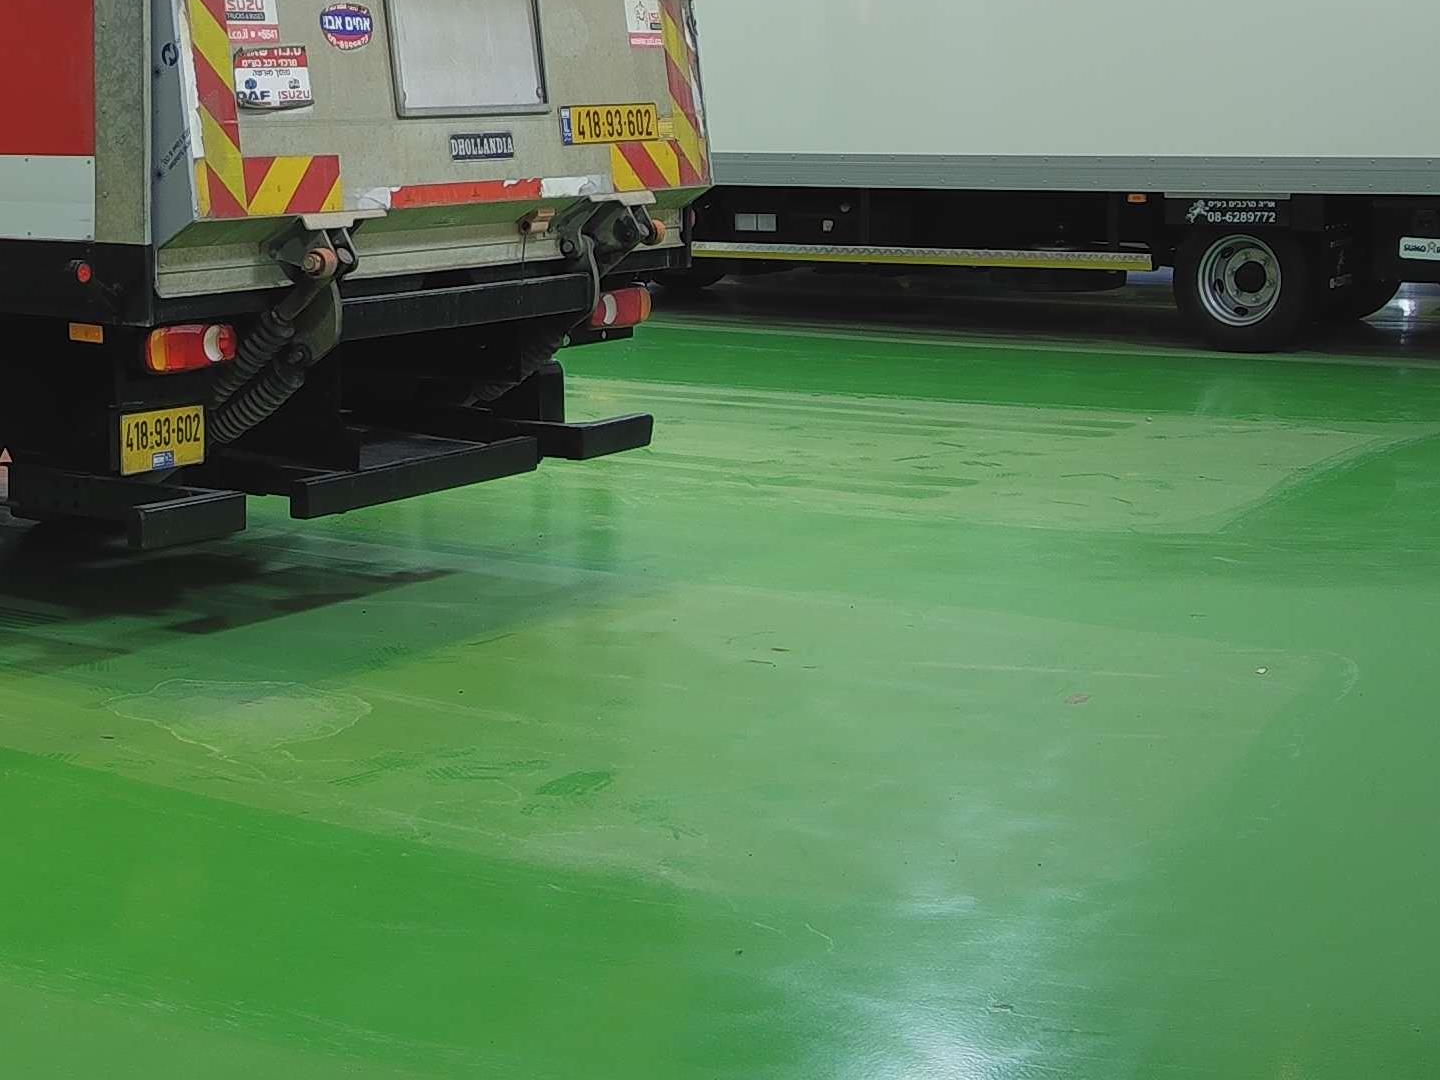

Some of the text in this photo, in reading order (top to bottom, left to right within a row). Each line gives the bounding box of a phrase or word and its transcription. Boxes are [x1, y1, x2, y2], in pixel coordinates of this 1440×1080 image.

[226, 0, 264, 10] SUZU
[345, 16, 371, 31] אחים
[278, 89, 310, 100] ISUZU
[450, 135, 515, 157] DHOLLANDIA
[1207, 211, 1276, 223] 08-6289772
[126, 412, 201, 452] 418-93-602
